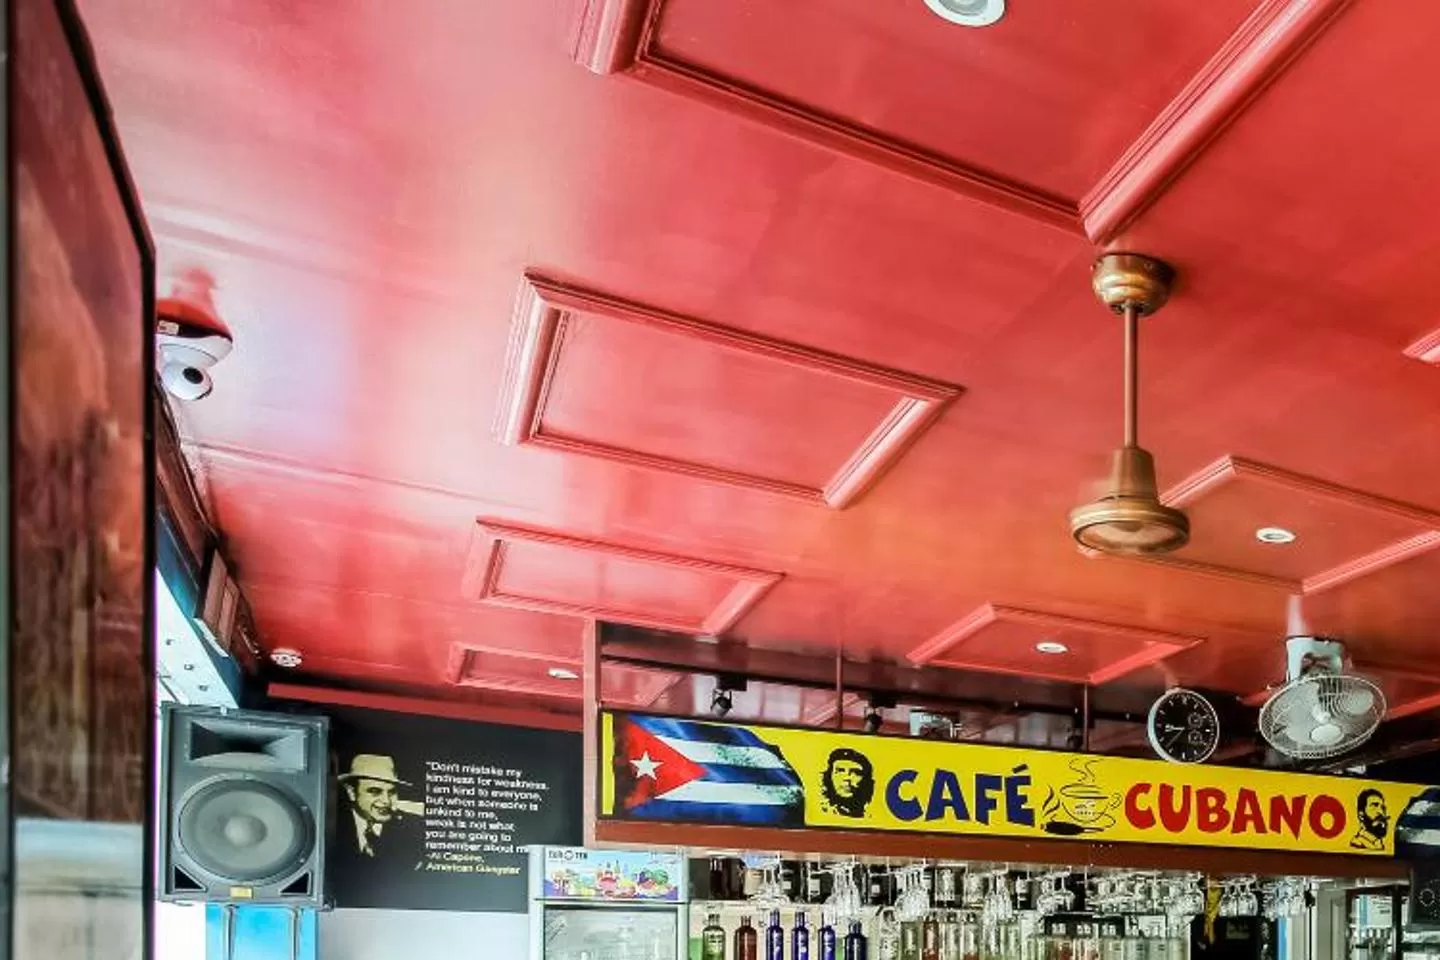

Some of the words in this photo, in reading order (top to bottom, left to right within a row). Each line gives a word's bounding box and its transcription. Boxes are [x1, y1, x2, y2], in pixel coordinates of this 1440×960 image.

[462, 764, 504, 776] mistake
[506, 768, 522, 778] my
[426, 773, 475, 784] kindness
[478, 777, 492, 786] for
[453, 785, 475, 795] kind
[478, 788, 488, 797] to
[426, 795, 444, 804] but
[446, 796, 475, 807] when
[478, 800, 527, 810] someone
[529, 803, 538, 811] is
[885, 763, 1036, 827] CAFÉ
[1124, 782, 1347, 840] CUBANO
[426, 807, 461, 817] unkind
[464, 809, 475, 818] to
[469, 821, 486, 830] not
[426, 831, 445, 839] you
[448, 831, 466, 839] are
[468, 832, 498, 842] going
[501, 832, 511, 841] to
[426, 841, 481, 851] remember
[483, 844, 513, 853] about
[426, 862, 473, 873] American
[476, 864, 520, 875] Gangster
